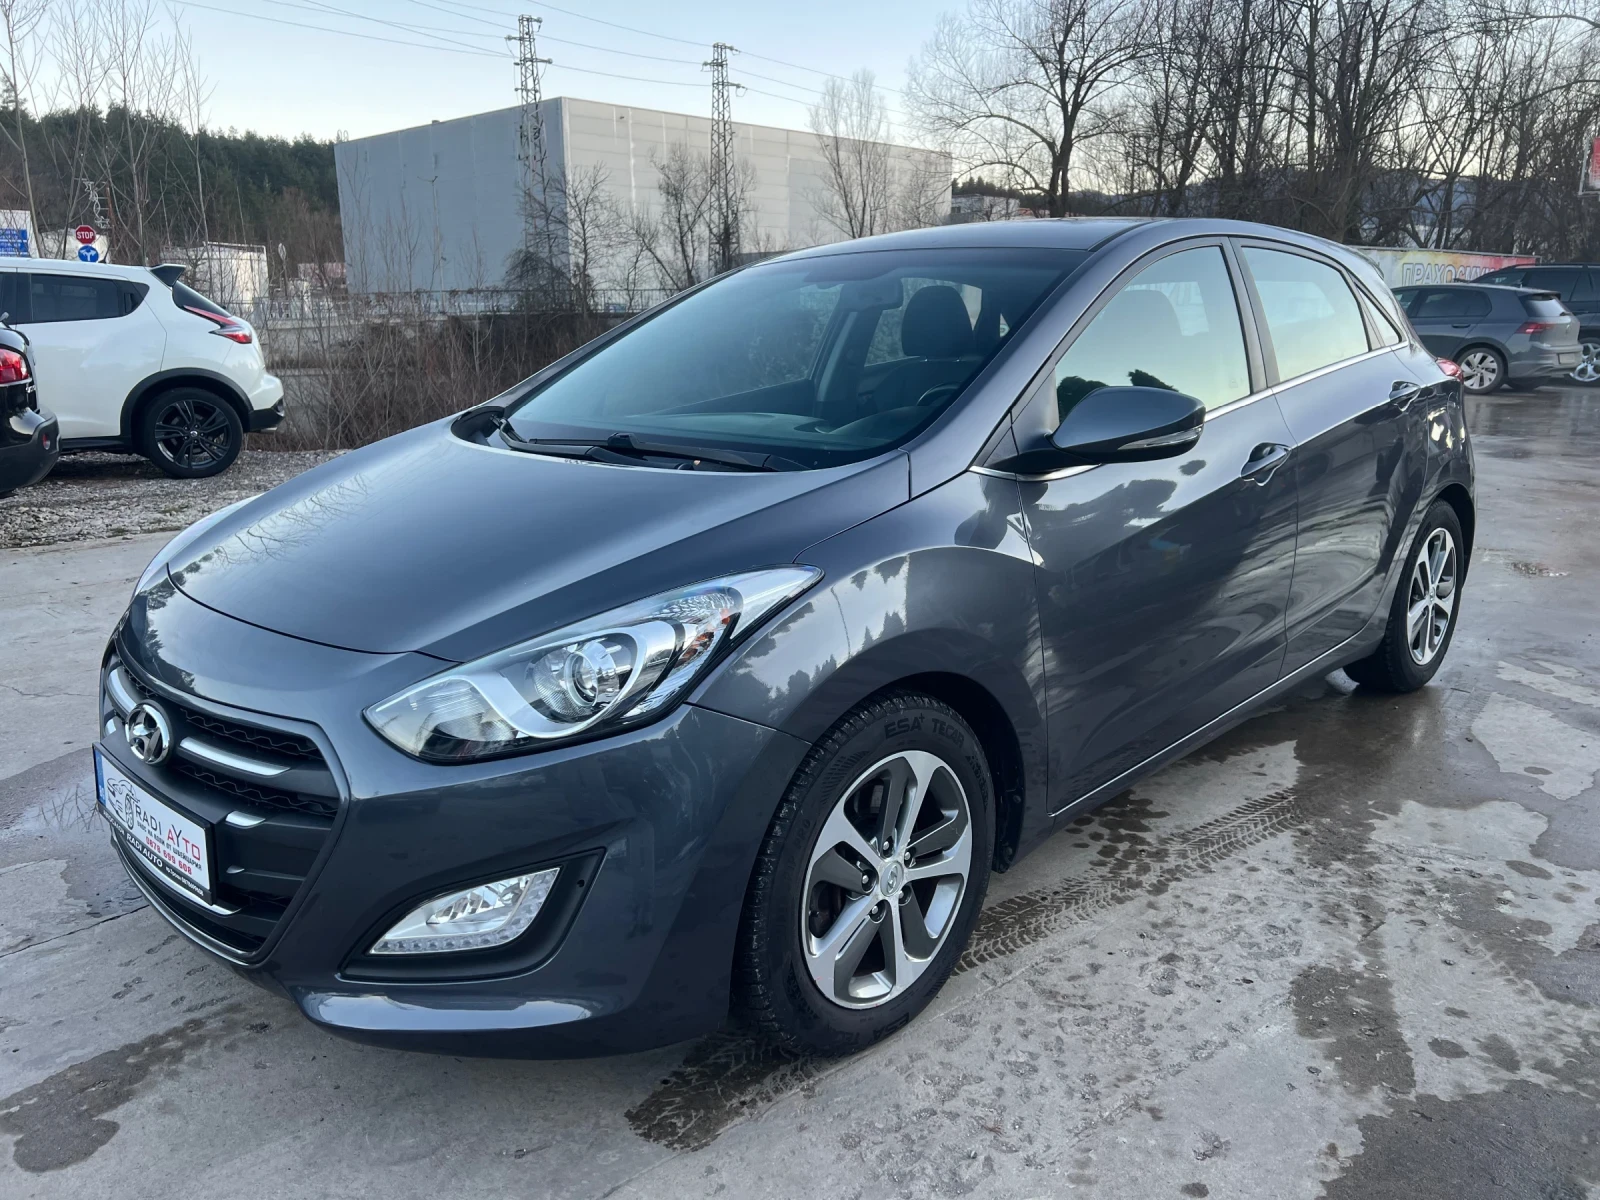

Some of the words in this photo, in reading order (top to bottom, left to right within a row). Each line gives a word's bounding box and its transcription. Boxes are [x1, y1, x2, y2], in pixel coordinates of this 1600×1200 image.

[77, 231, 94, 239] STOP
[931, 716, 965, 748] TECAR
[135, 804, 162, 836] RADI
[126, 833, 142, 851] RADI
[142, 848, 163, 868] AUTO
[146, 836, 161, 854] 0878
[178, 860, 192, 875] 608
